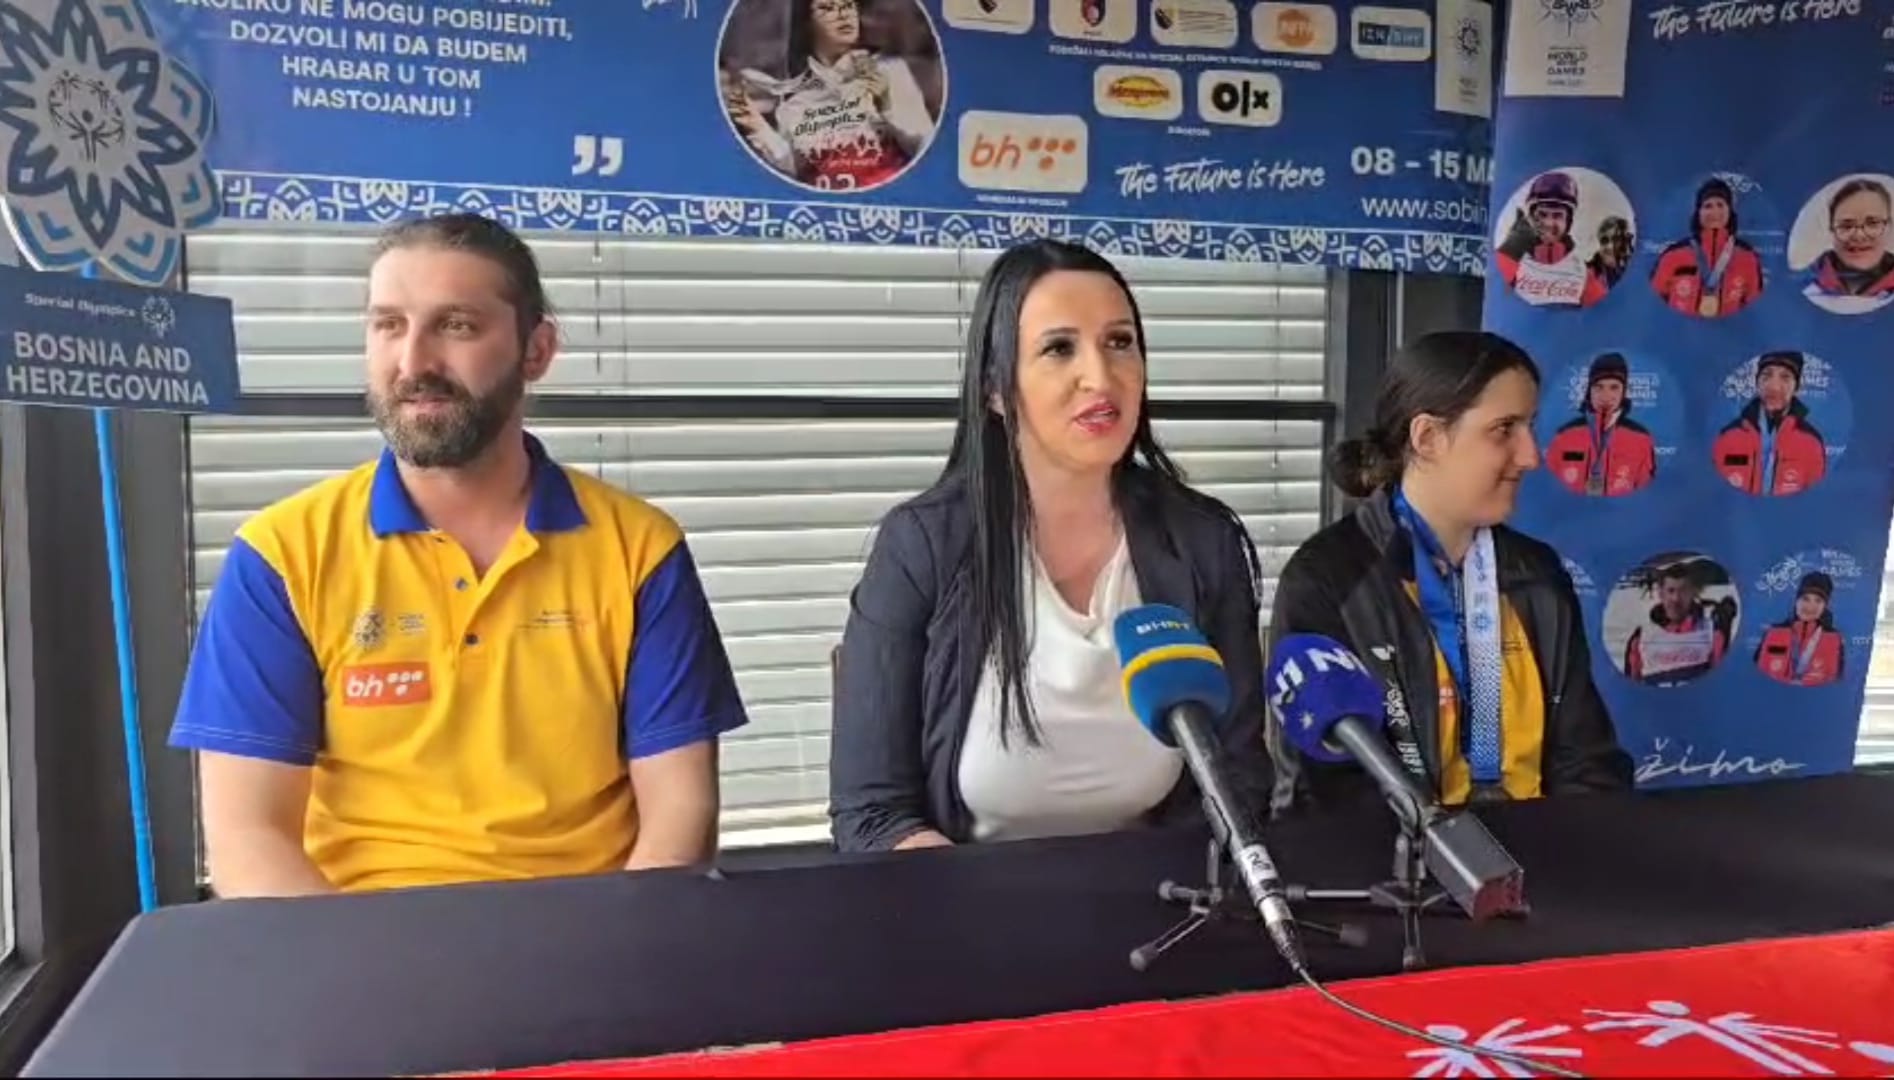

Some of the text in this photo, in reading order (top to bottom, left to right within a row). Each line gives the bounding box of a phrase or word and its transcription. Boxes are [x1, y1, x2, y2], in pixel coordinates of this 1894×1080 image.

[174, 0, 573, 41] LIKO NE MOGU POBIJEDITI,
[1650, 5, 1690, 40] The
[1696, 0, 1775, 33] Future
[1780, 1, 1799, 22] is
[230, 20, 527, 63] DOZVOLI MI DA BUDEM
[282, 56, 481, 89] HRABAR U TOM
[293, 87, 456, 116] NASTOJANJU
[1115, 158, 1326, 200] The Future is Here
[1351, 146, 1396, 176] 08
[1429, 149, 1461, 180] 15
[14, 331, 192, 373] BOSNIA AND
[6, 364, 210, 406] HERZEGOVINA
